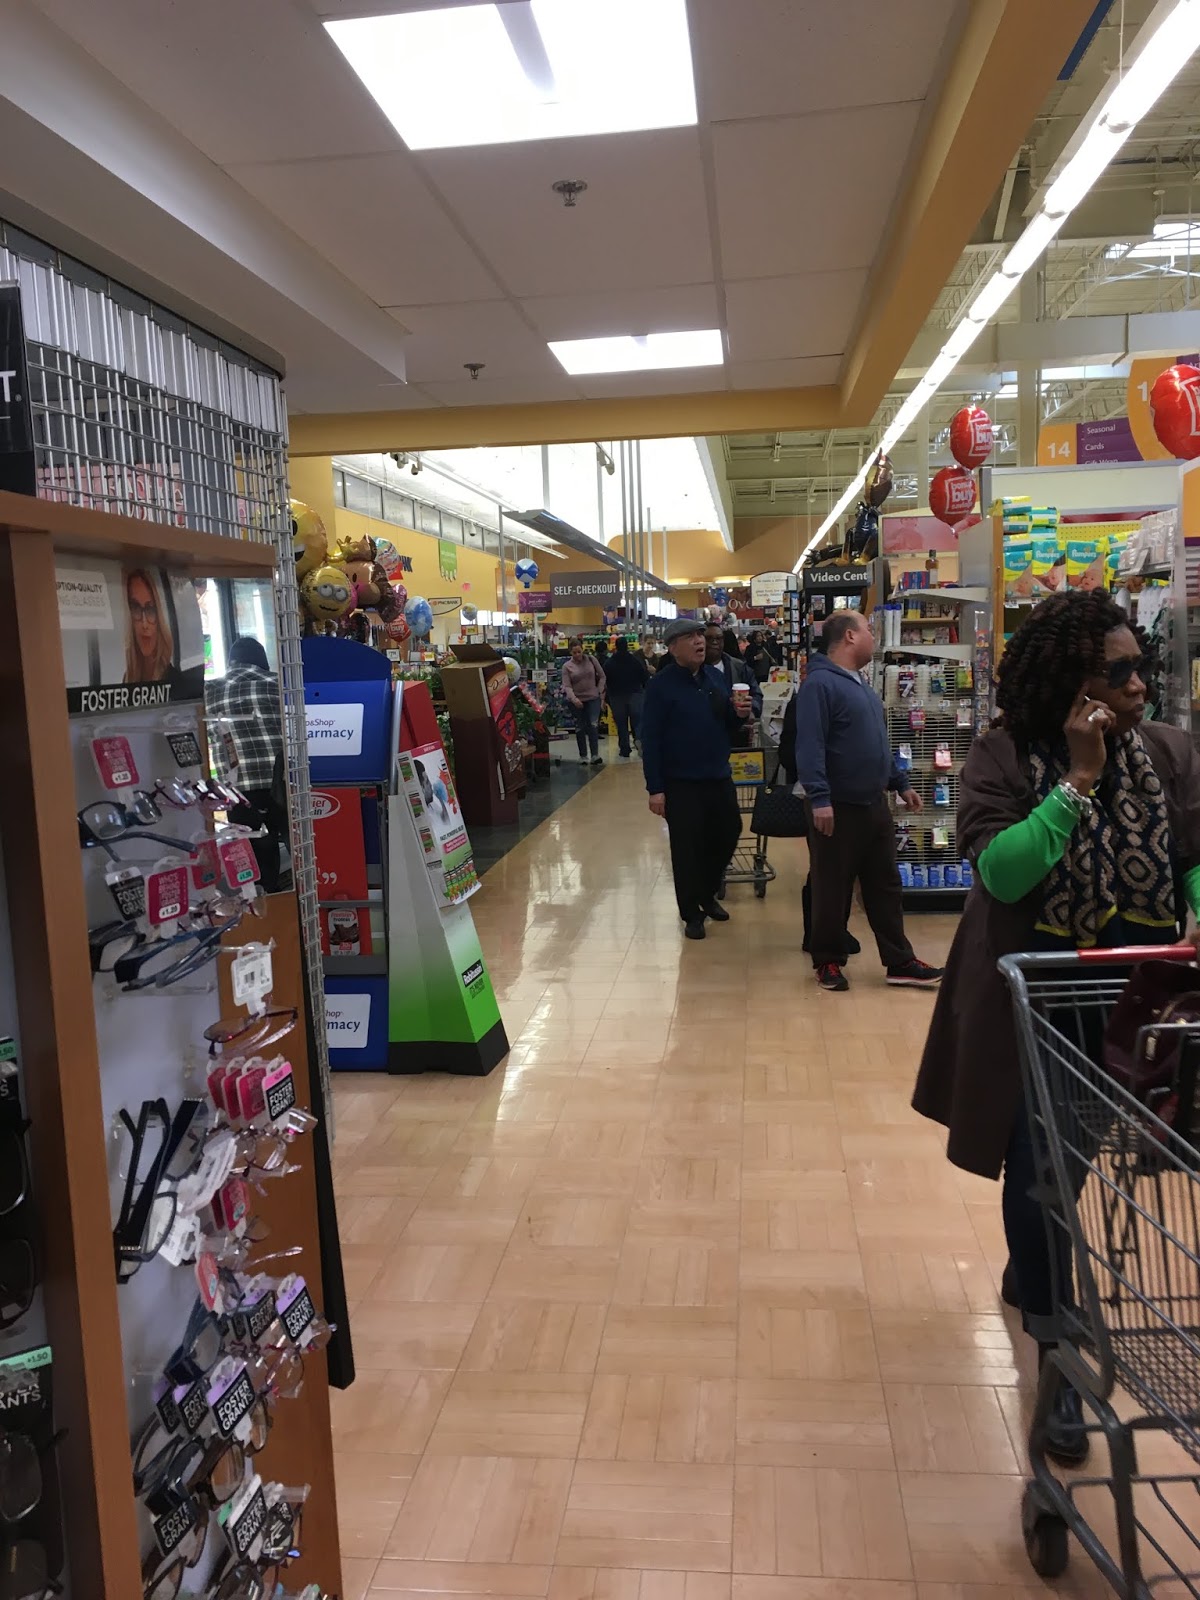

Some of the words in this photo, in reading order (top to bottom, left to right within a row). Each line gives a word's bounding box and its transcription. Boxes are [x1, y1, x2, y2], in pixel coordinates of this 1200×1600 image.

[1086, 424, 1116, 434] Seasonal
[1047, 441, 1071, 458] 14
[1085, 442, 1105, 451] Cards
[952, 489, 974, 502] buy
[1036, 550, 1060, 558] Pampers
[1072, 550, 1097, 559] Pampers
[810, 573, 840, 582] Video
[843, 571, 868, 581] Cent
[554, 584, 617, 596] SELF-CHECKOUT
[81, 687, 129, 713] FOSTER
[131, 684, 172, 707] GRANT
[307, 729, 354, 740] armacy
[327, 1021, 360, 1032] macy
[269, 1082, 293, 1106] FOSTER
[271, 1094, 295, 1118] GRANTS
[286, 1296, 311, 1328] FOSTER
[290, 1307, 314, 1338] GRANTS
[218, 1379, 250, 1421] FOSTER
[222, 1392, 253, 1431] GRANTS
[236, 1497, 264, 1541] FOSTER
